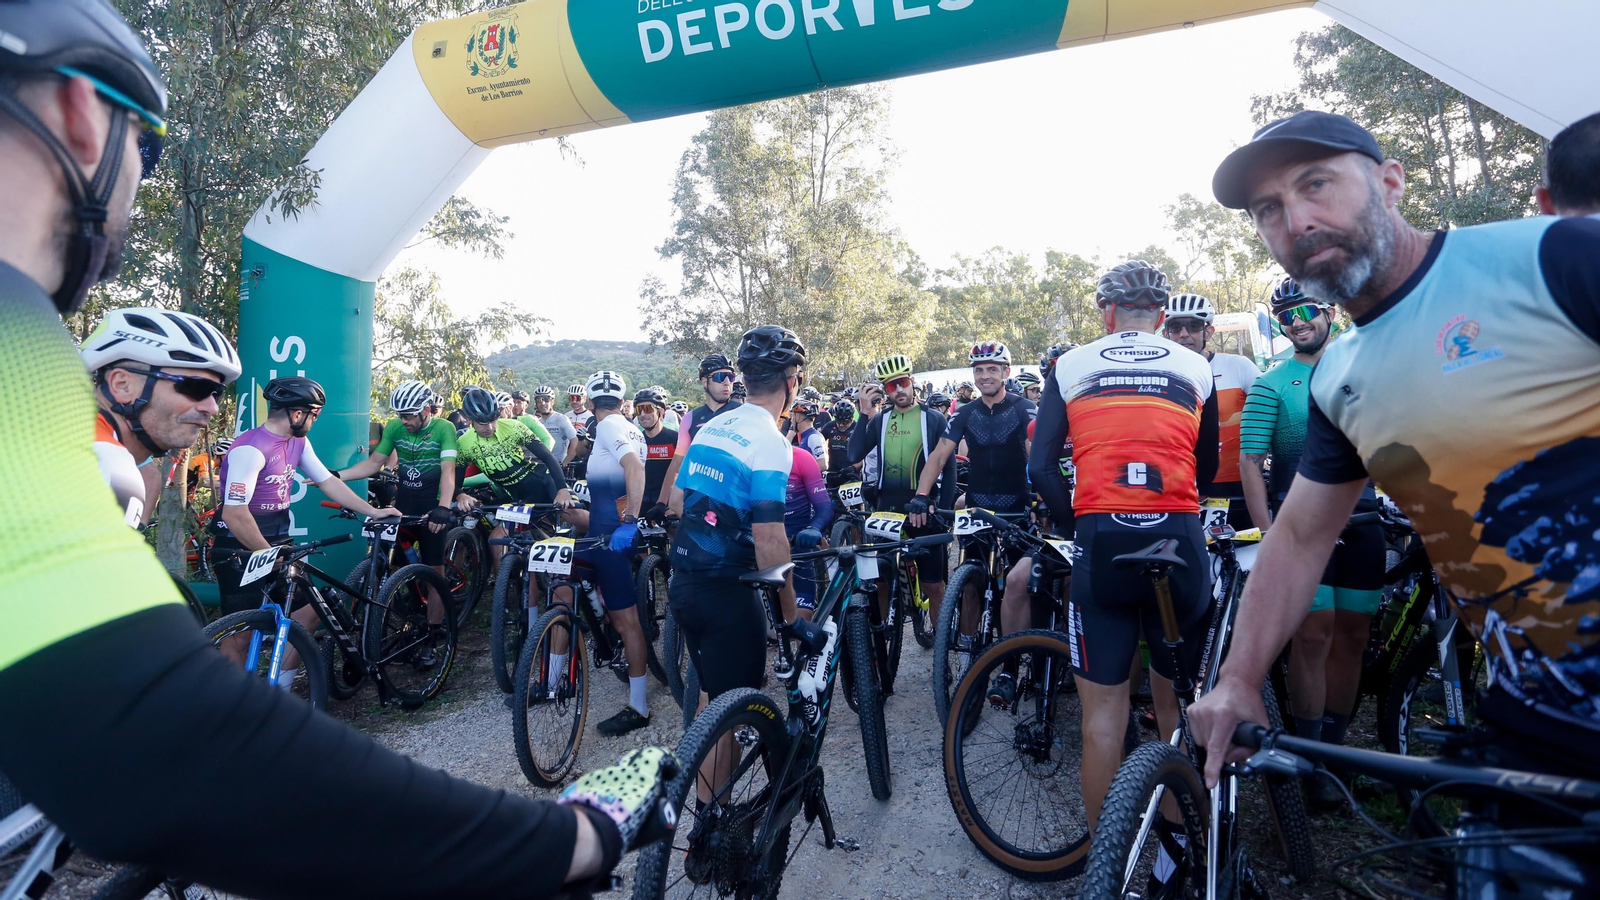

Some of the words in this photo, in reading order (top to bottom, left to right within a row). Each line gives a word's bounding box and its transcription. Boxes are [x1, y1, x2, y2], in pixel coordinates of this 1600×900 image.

[637, 0, 975, 64] DEPOR
[489, 77, 531, 91] Ayuntamiento
[481, 94, 489, 102] de
[490, 92, 501, 101] Los
[501, 89, 524, 99] Barrios
[112, 330, 168, 348] SCOTT
[1137, 385, 1162, 393] bikes
[649, 446, 668, 455] RACING
[695, 462, 724, 483] MACONDO
[1127, 463, 1147, 485] C
[574, 483, 590, 495] 01
[839, 487, 861, 501] 352
[260, 503, 275, 511] 512
[867, 517, 902, 534] 272
[247, 546, 281, 574] 062
[532, 544, 573, 564] 279
[887, 606, 896, 627] FOX
[1198, 627, 1216, 678] SUPERCALIBER
[746, 704, 776, 720] MAXXIS
[949, 775, 974, 826] MAXXIS
